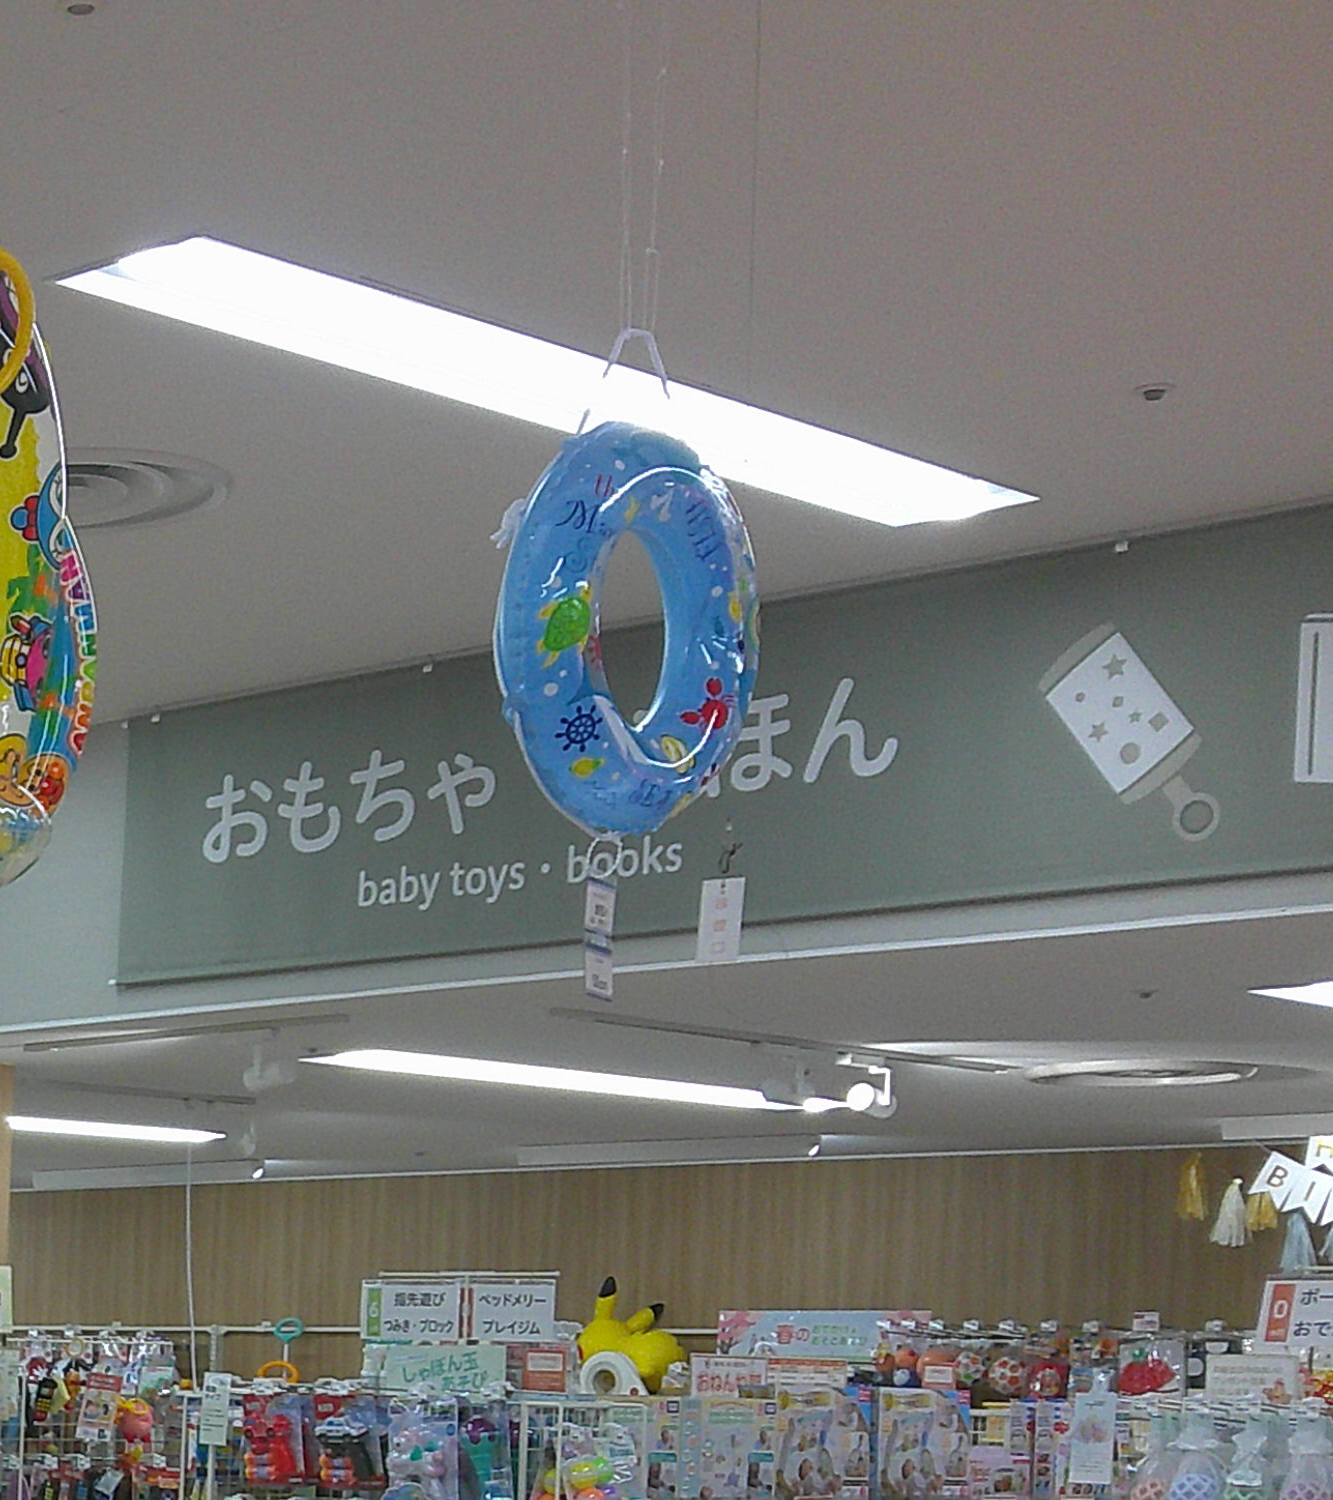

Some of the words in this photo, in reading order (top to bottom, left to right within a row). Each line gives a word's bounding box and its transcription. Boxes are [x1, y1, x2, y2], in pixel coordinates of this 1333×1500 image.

[357, 869, 441, 911] baby
[450, 857, 526, 903] toys
[566, 837, 683, 884] books
[394, 1292, 445, 1308] 指先遊び
[478, 1293, 547, 1308] ベッドメリー
[368, 1301, 379, 1318] 6
[383, 1318, 455, 1335] つみき・ブロック
[483, 1319, 541, 1335] プレイジム
